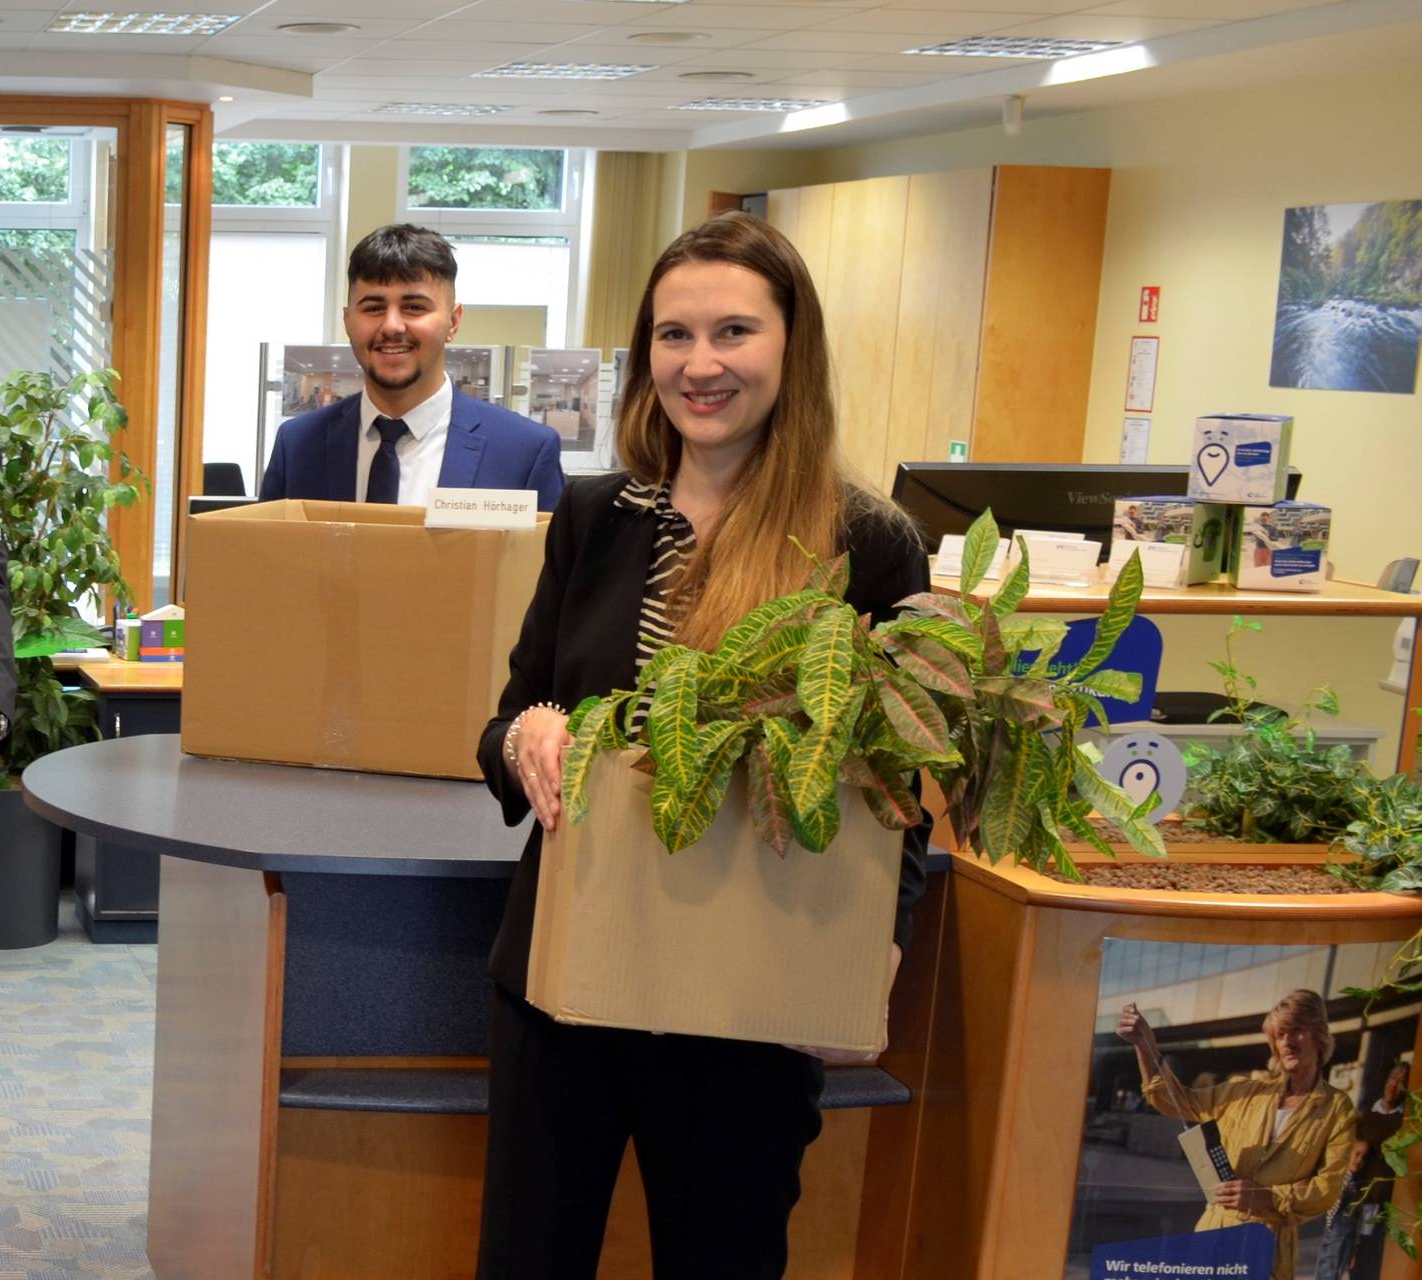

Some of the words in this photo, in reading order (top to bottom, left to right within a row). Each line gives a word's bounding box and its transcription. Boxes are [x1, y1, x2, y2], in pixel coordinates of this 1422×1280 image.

[434, 499, 478, 510] Christian
[1105, 1260, 1131, 1272] Wir
[1133, 1261, 1214, 1275] telefonieren
[1216, 1263, 1249, 1275] nicht
